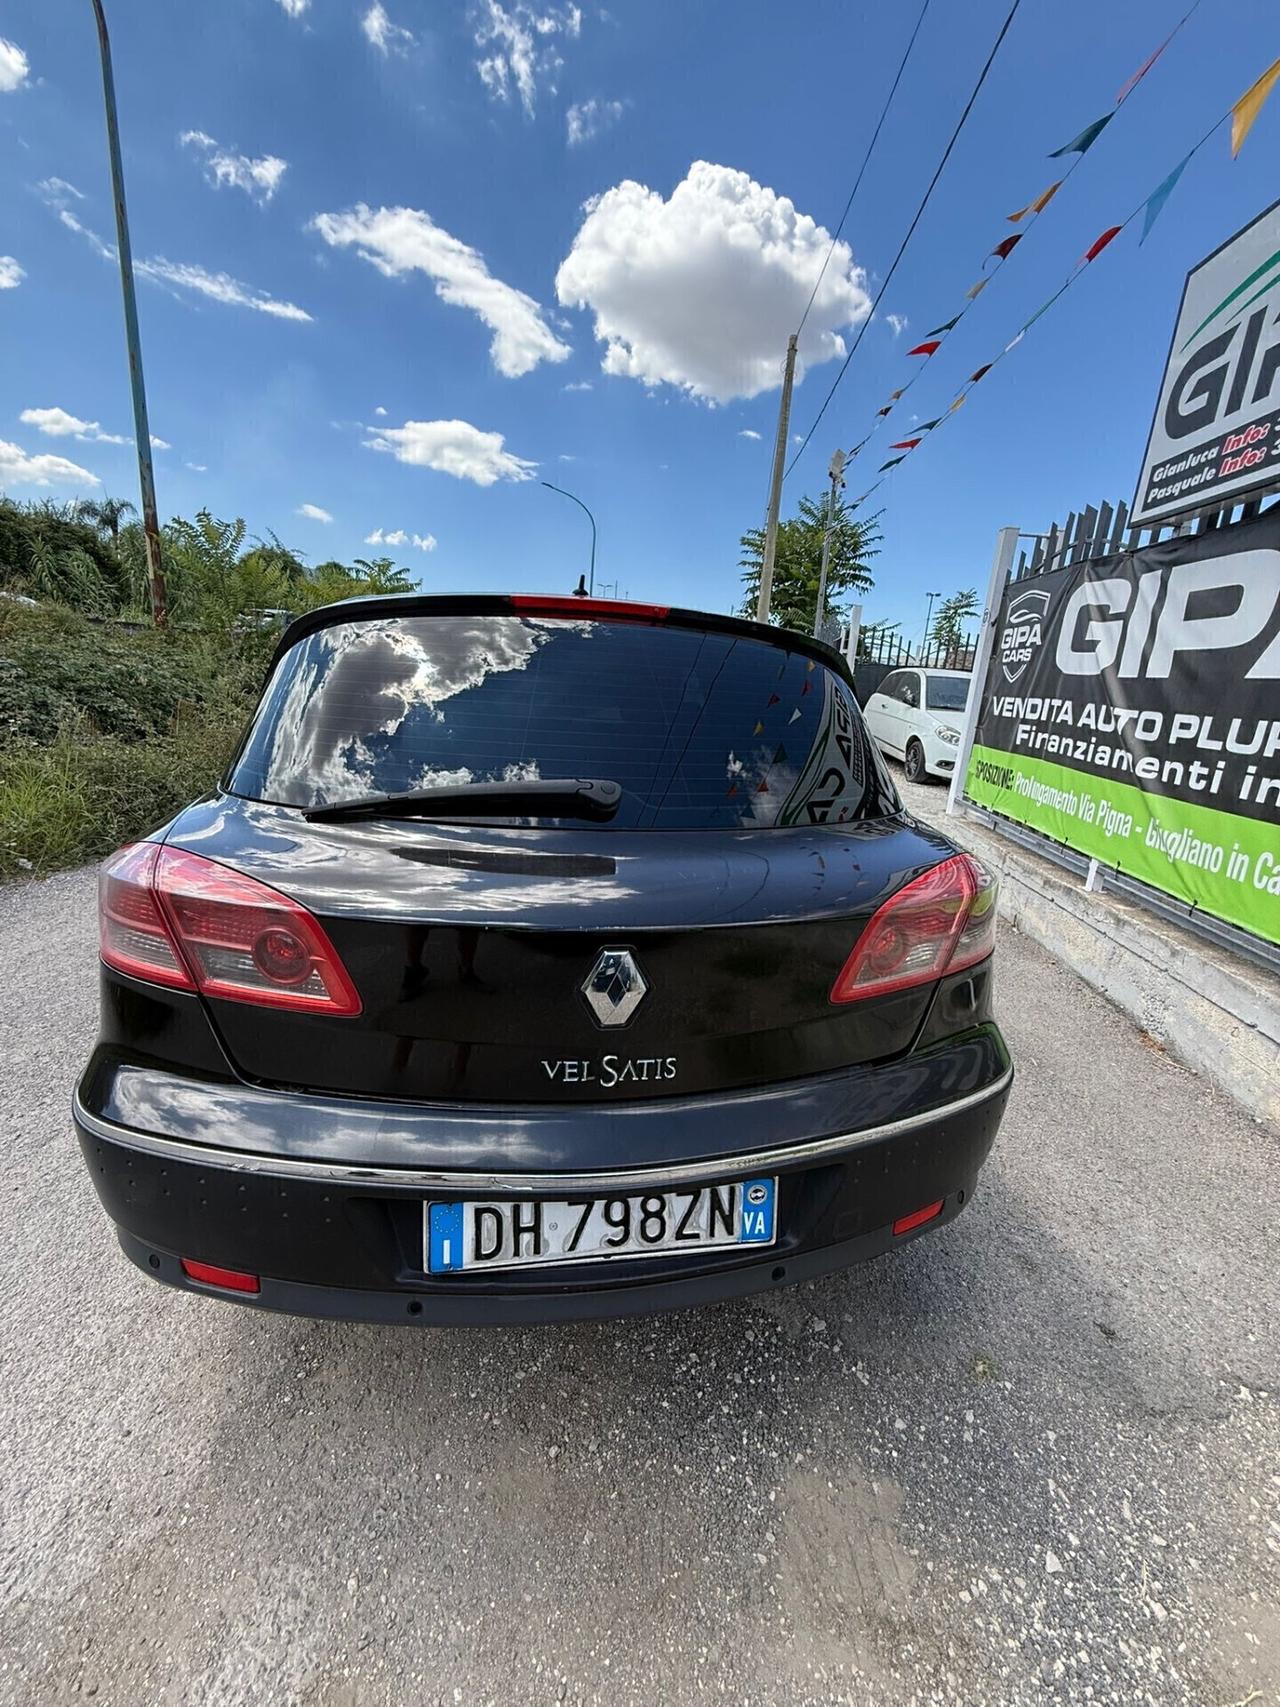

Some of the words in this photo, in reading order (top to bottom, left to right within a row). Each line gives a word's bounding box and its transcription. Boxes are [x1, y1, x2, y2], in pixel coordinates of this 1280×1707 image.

[1147, 467, 1216, 503] Pasquale
[1218, 447, 1267, 477] Info:
[1153, 446, 1219, 482] Gianluca
[1222, 423, 1271, 455] Info:
[1001, 623, 1042, 649] GIPA
[1002, 648, 1032, 663] CARS
[992, 696, 1073, 726] VENDITA
[1077, 703, 1163, 742] AUTO
[1015, 724, 1226, 793] Finanziamenti
[1013, 771, 1078, 816] Prolungamento
[1078, 793, 1095, 823] Via
[1096, 799, 1133, 838] Pigna
[1145, 817, 1223, 873] Giugliano
[1226, 842, 1250, 882] in
[541, 1060, 596, 1082] VEL
[474, 1204, 541, 1261] DH
[566, 1185, 736, 1252] 798ZN
[743, 1211, 766, 1235] VA
[442, 1239, 451, 1264] I
